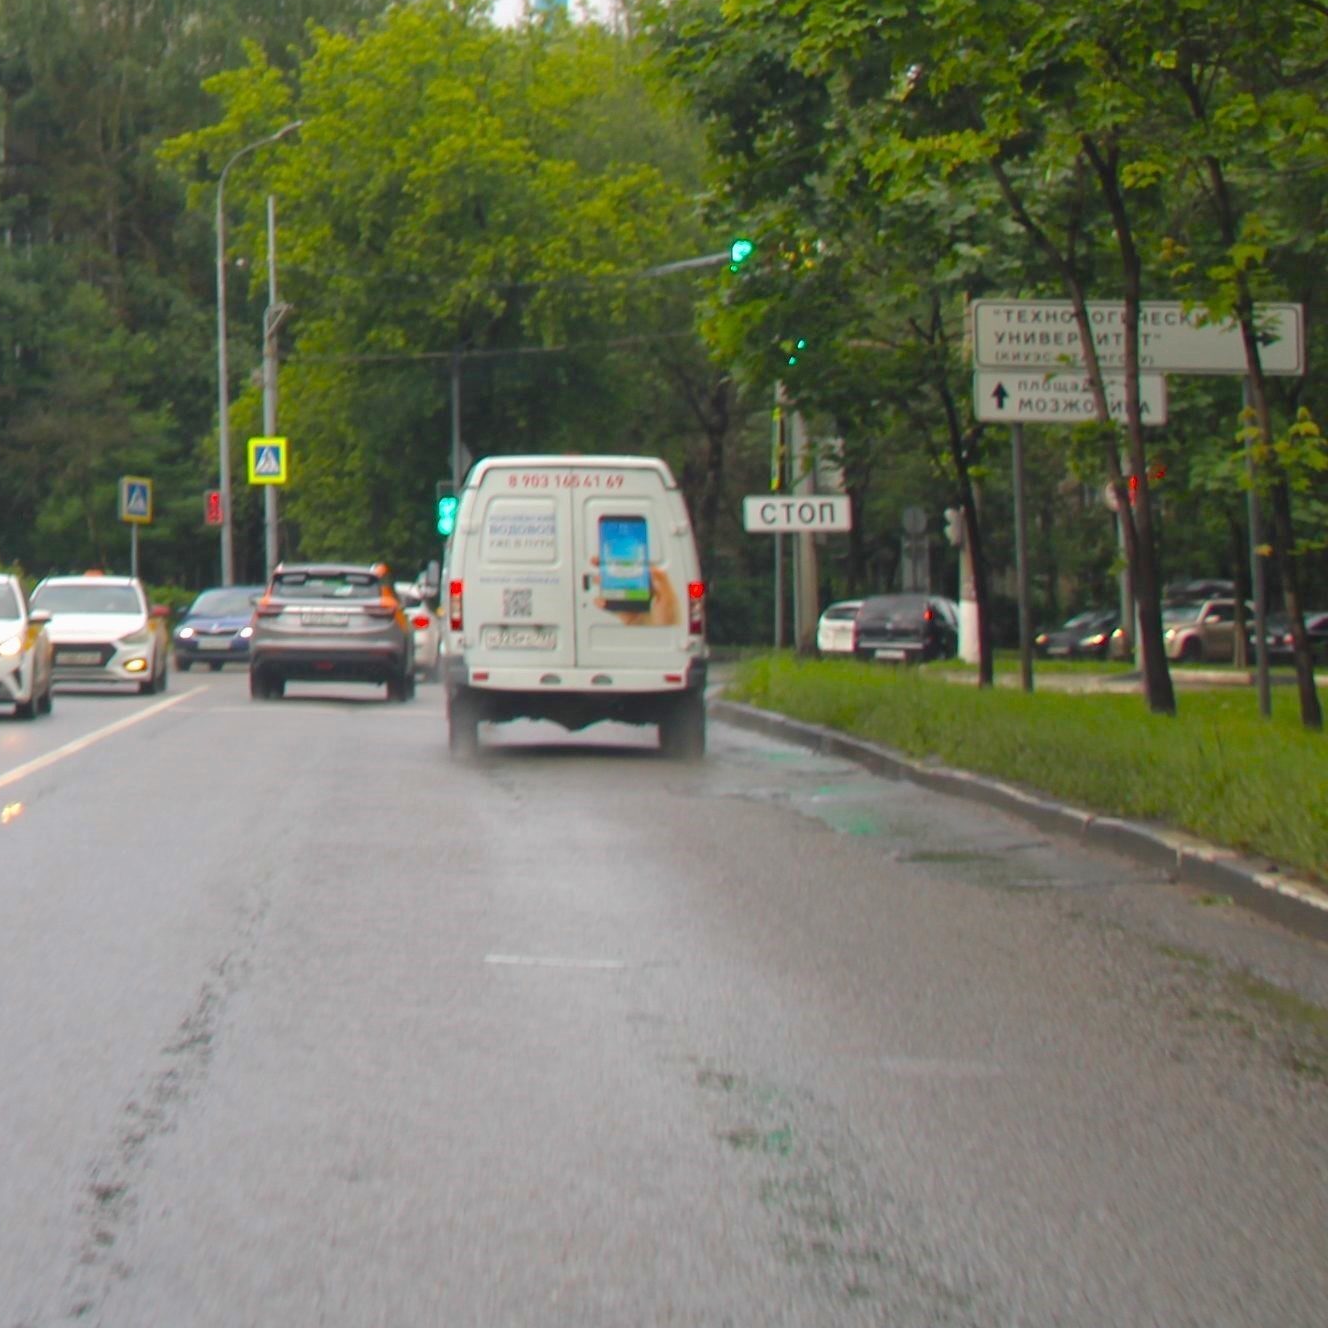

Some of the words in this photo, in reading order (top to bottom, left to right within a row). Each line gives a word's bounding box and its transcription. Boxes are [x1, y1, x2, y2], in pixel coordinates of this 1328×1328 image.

[993, 331, 1162, 346] УНИВЕРИТТ"
[1018, 397, 1151, 414] МОЗЖОИА
[760, 502, 835, 525] СТОП
